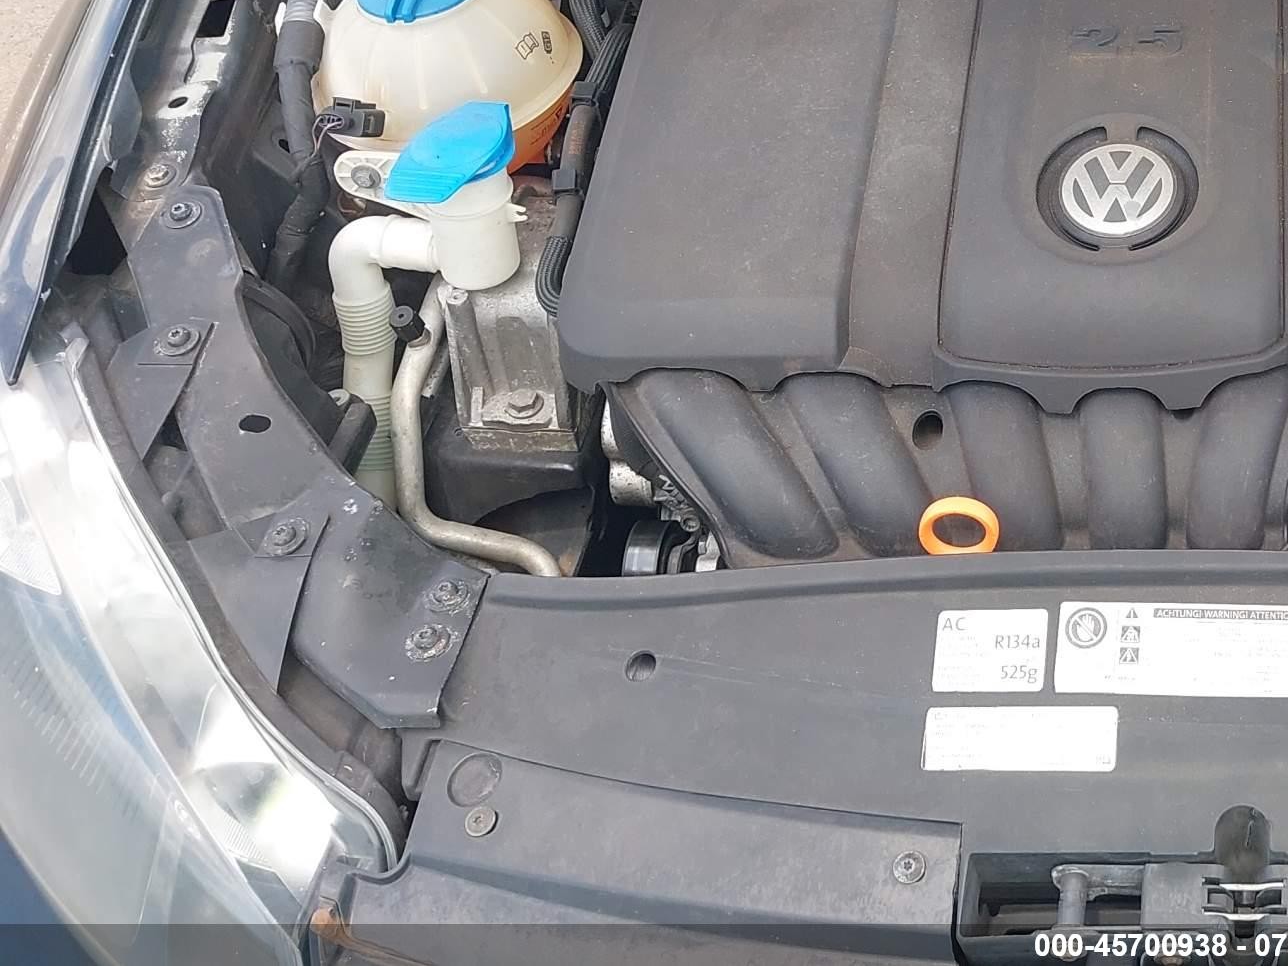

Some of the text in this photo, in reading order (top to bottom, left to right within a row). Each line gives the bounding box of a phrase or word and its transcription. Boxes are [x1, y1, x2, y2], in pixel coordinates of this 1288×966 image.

[1156, 608, 1202, 618] ACHTUNG!
[1203, 609, 1248, 619] WARNING!
[995, 634, 1040, 650] R134a
[1000, 664, 1038, 684] 525g
